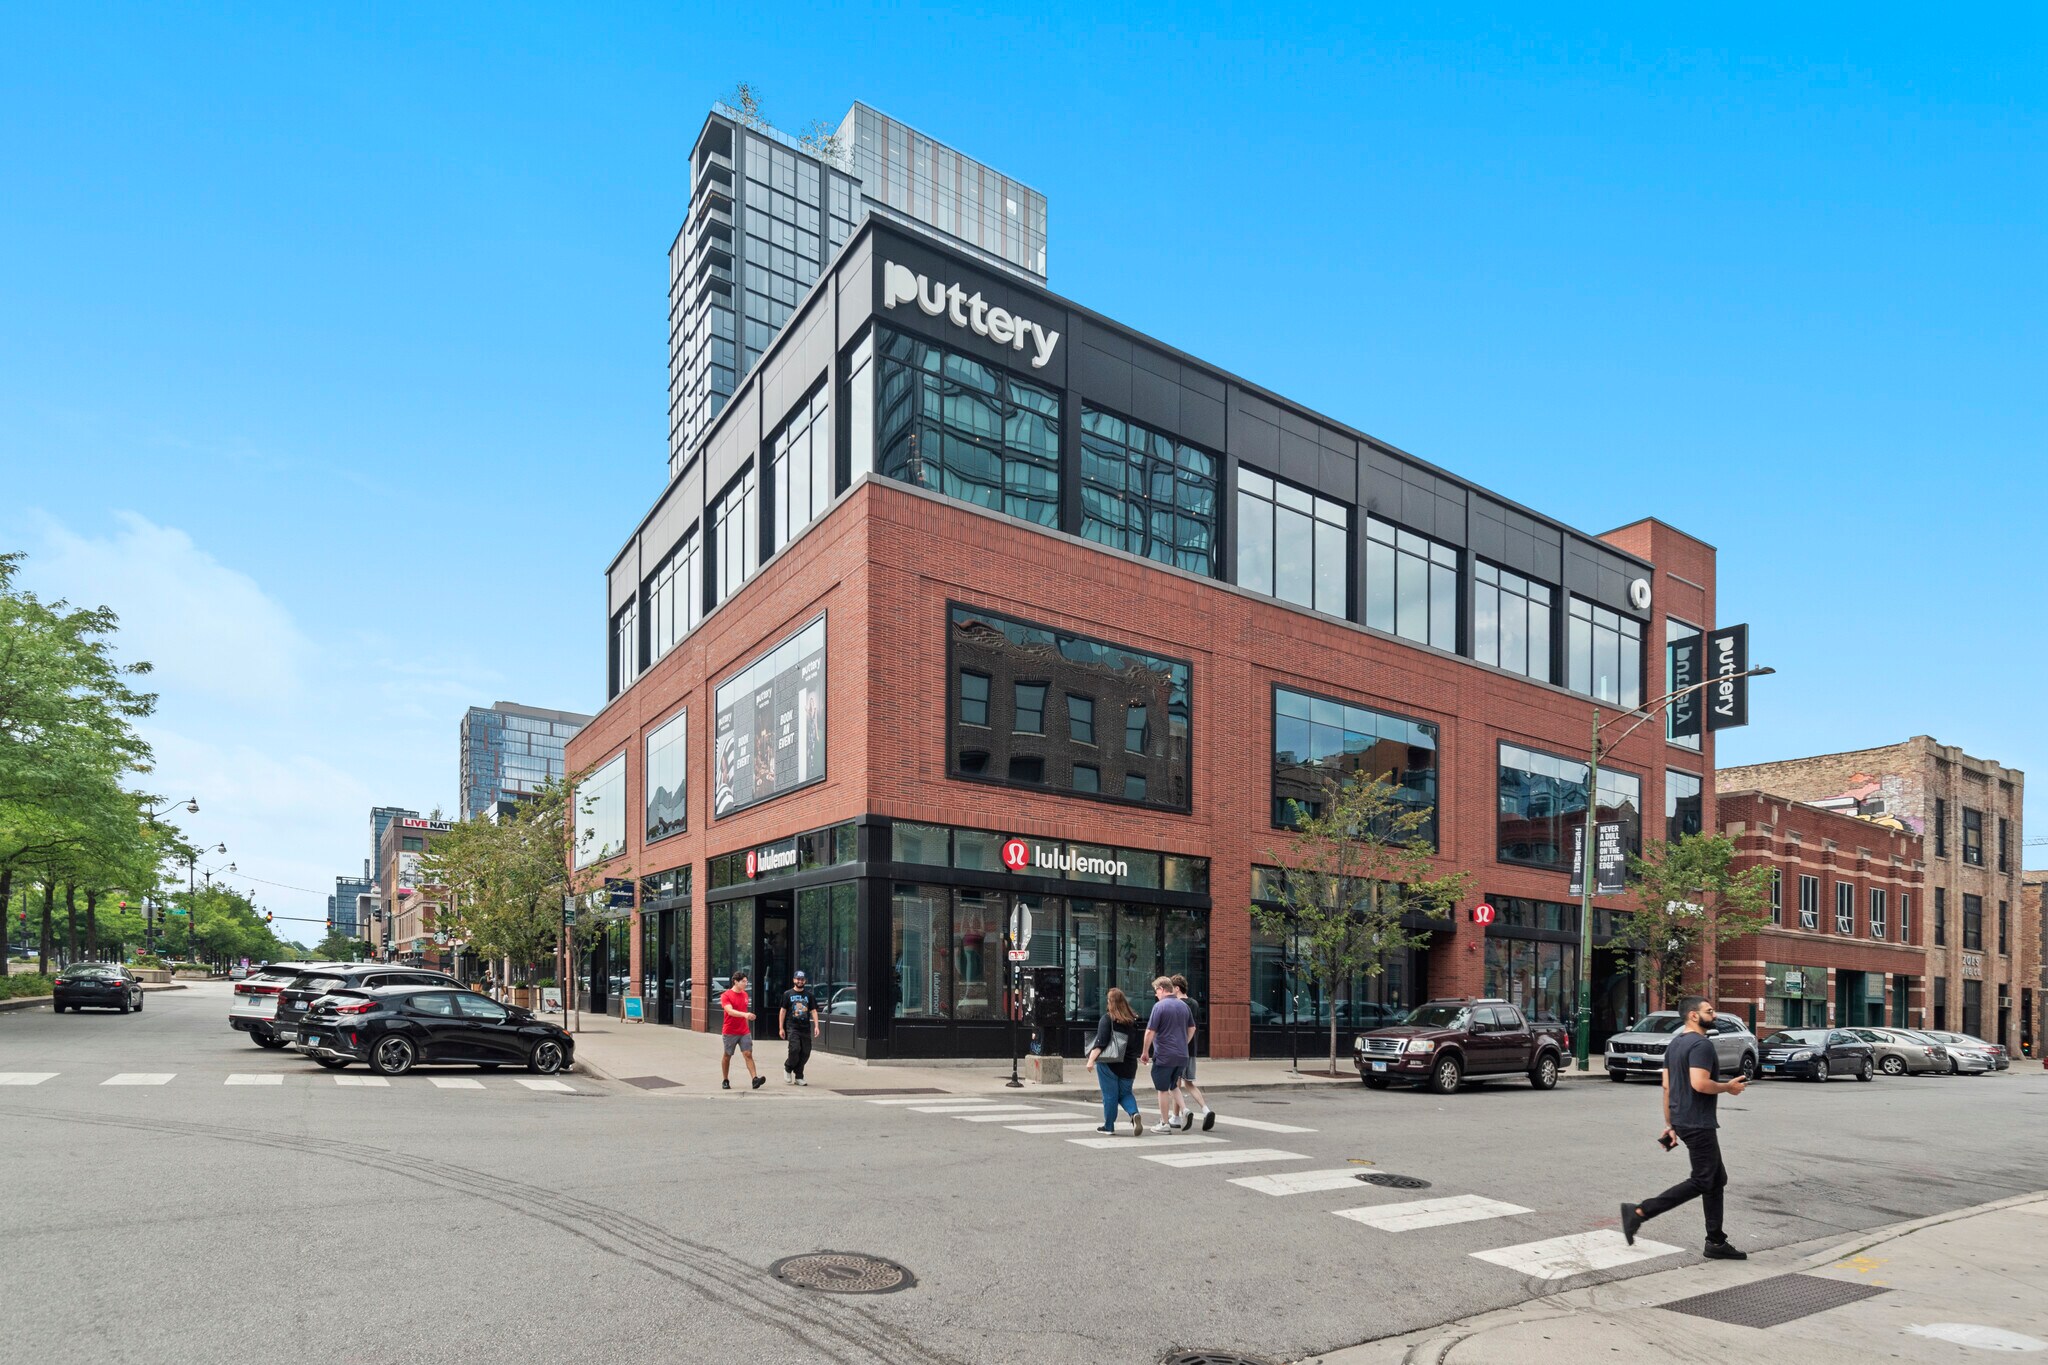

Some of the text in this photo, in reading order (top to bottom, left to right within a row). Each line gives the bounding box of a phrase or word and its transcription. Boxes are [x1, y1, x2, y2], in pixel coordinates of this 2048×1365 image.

[884, 260, 1060, 368] puttery
[802, 657, 821, 679] puttery
[780, 709, 793, 726] BOOK
[783, 722, 790, 736] AN
[779, 732, 795, 750] EVENT
[405, 819, 452, 830] LIVE NATI
[1600, 825, 1619, 833] NEVER
[1605, 832, 1620, 840] DULL
[757, 849, 797, 872] lululemon
[1035, 846, 1128, 877] lululemon
[1600, 854, 1624, 862] CUTTING
[790, 995, 809, 1003] UCLA
